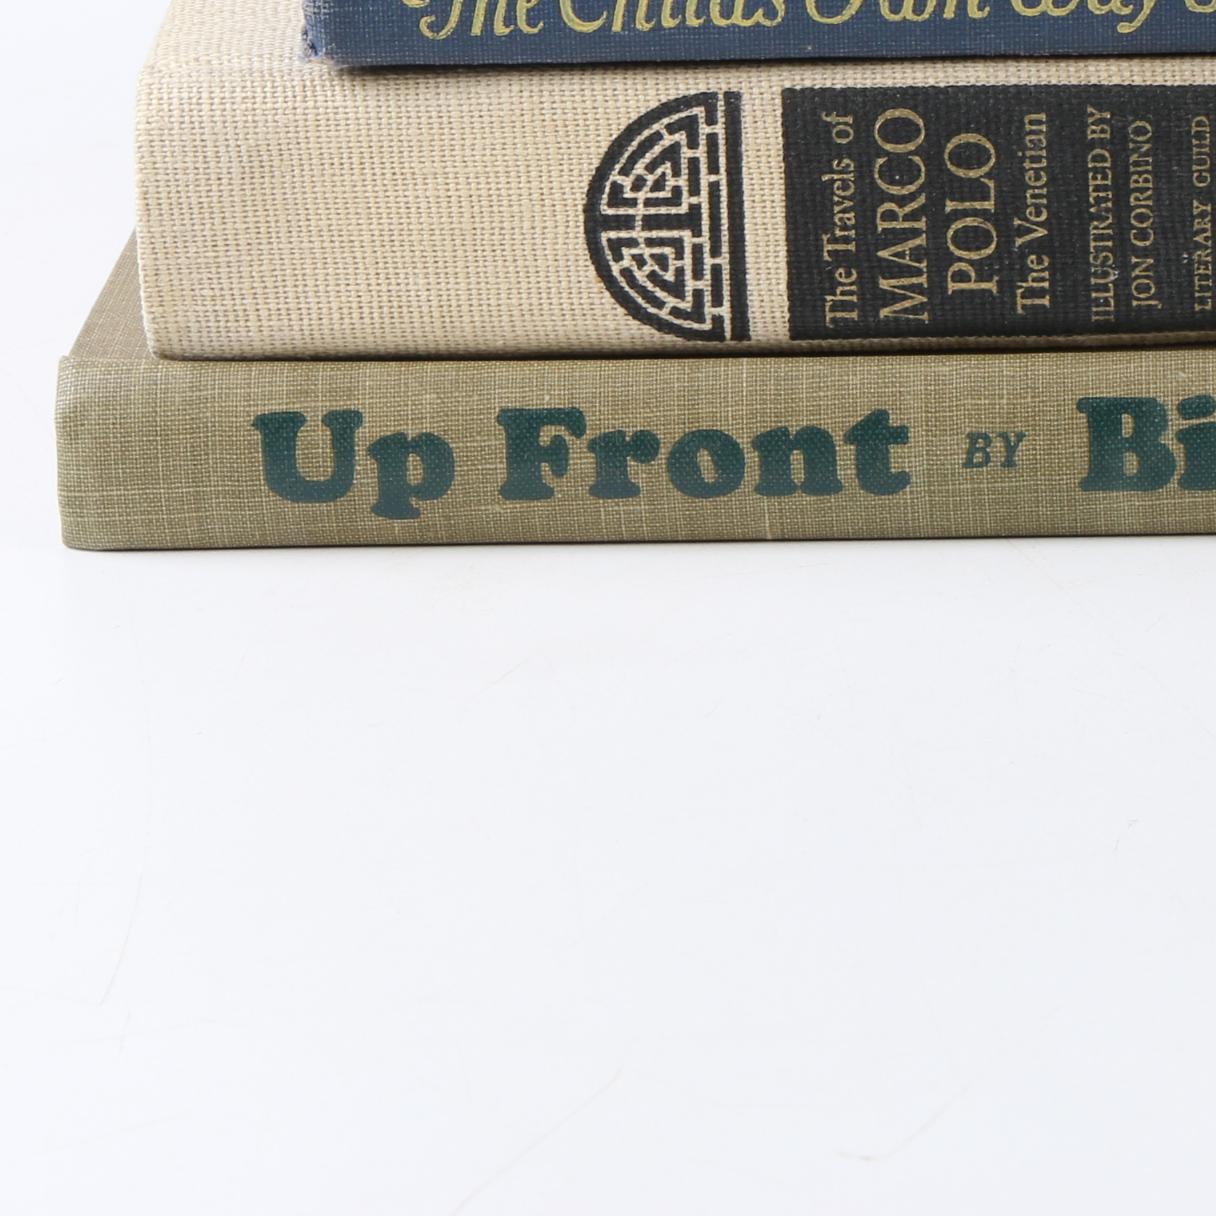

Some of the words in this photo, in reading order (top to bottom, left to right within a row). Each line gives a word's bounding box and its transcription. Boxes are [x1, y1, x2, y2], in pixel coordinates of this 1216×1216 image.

[821, 111, 855, 145] of
[1086, 104, 1113, 141] BY
[1191, 115, 1212, 189] GUILD
[821, 155, 857, 262] Travels
[873, 107, 930, 324] MARCO
[943, 131, 998, 296] POLO
[1014, 111, 1049, 247] Venetian
[1128, 119, 1154, 248] CORBINO
[1015, 254, 1051, 315] The
[1088, 148, 1116, 323] ILLUSTRATED
[1131, 256, 1163, 310] JON
[1192, 198, 1214, 313] LITERARY
[822, 266, 859, 329] The
[252, 408, 456, 520] Up
[496, 406, 911, 500] Front
[962, 430, 1026, 469] BY
